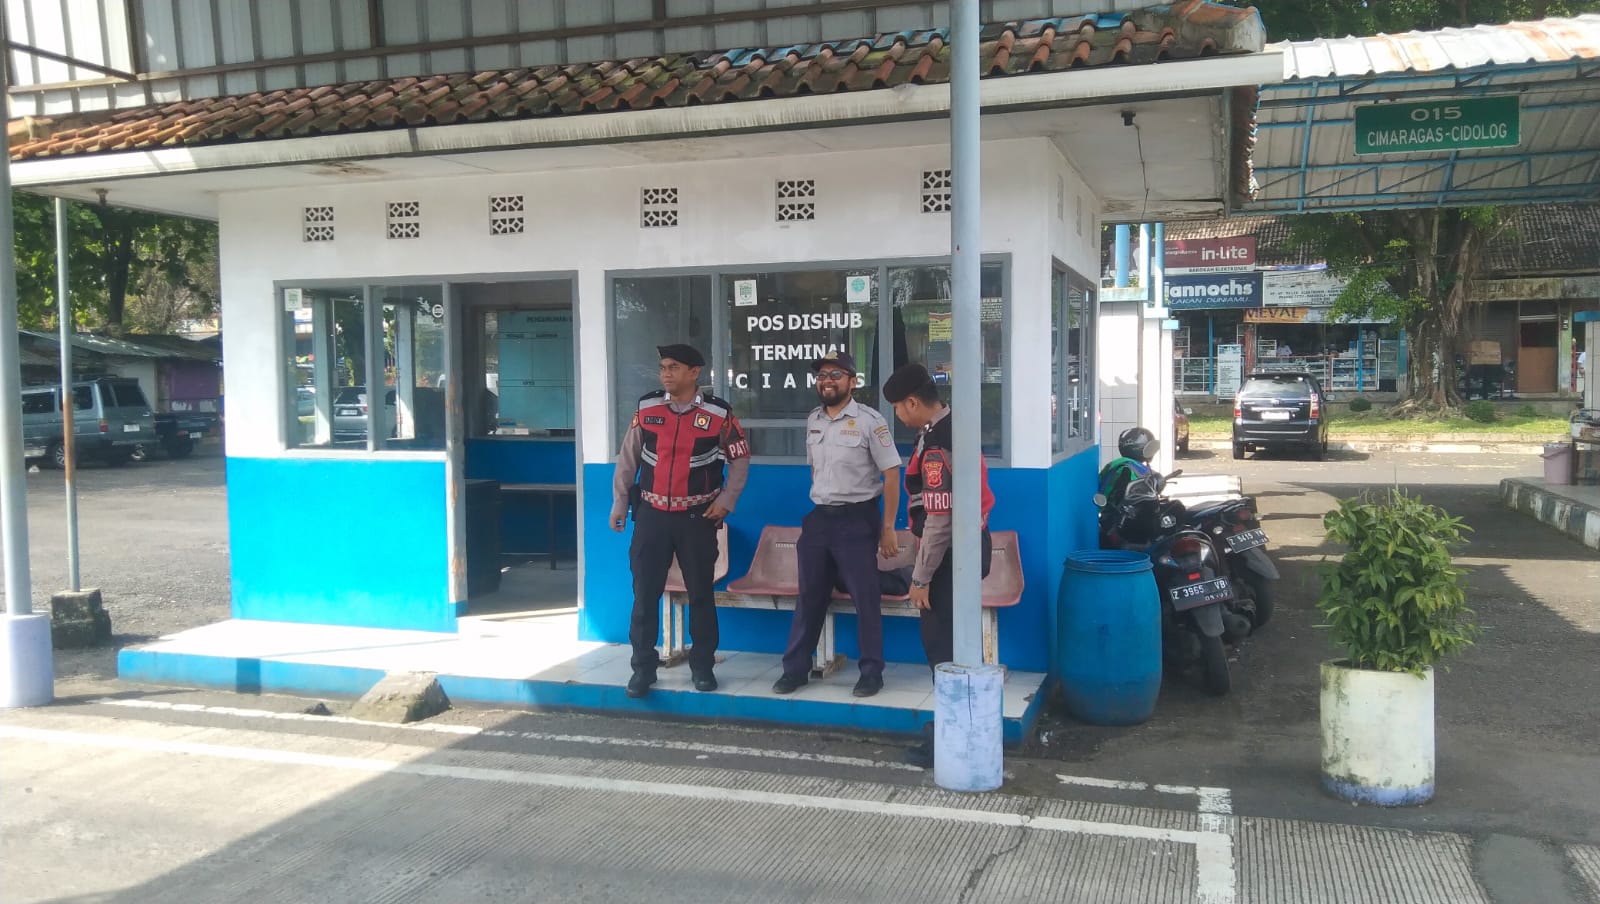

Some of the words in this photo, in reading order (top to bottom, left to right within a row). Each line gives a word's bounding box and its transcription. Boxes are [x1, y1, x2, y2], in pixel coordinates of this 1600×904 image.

[1410, 106, 1463, 121] 015
[1367, 123, 1508, 147] CIMARAGAS-CIDOLOG
[747, 314, 785, 332] POS
[788, 312, 863, 331] DISHUB
[1172, 590, 1180, 600] Z
[1182, 584, 1205, 597] 3965
